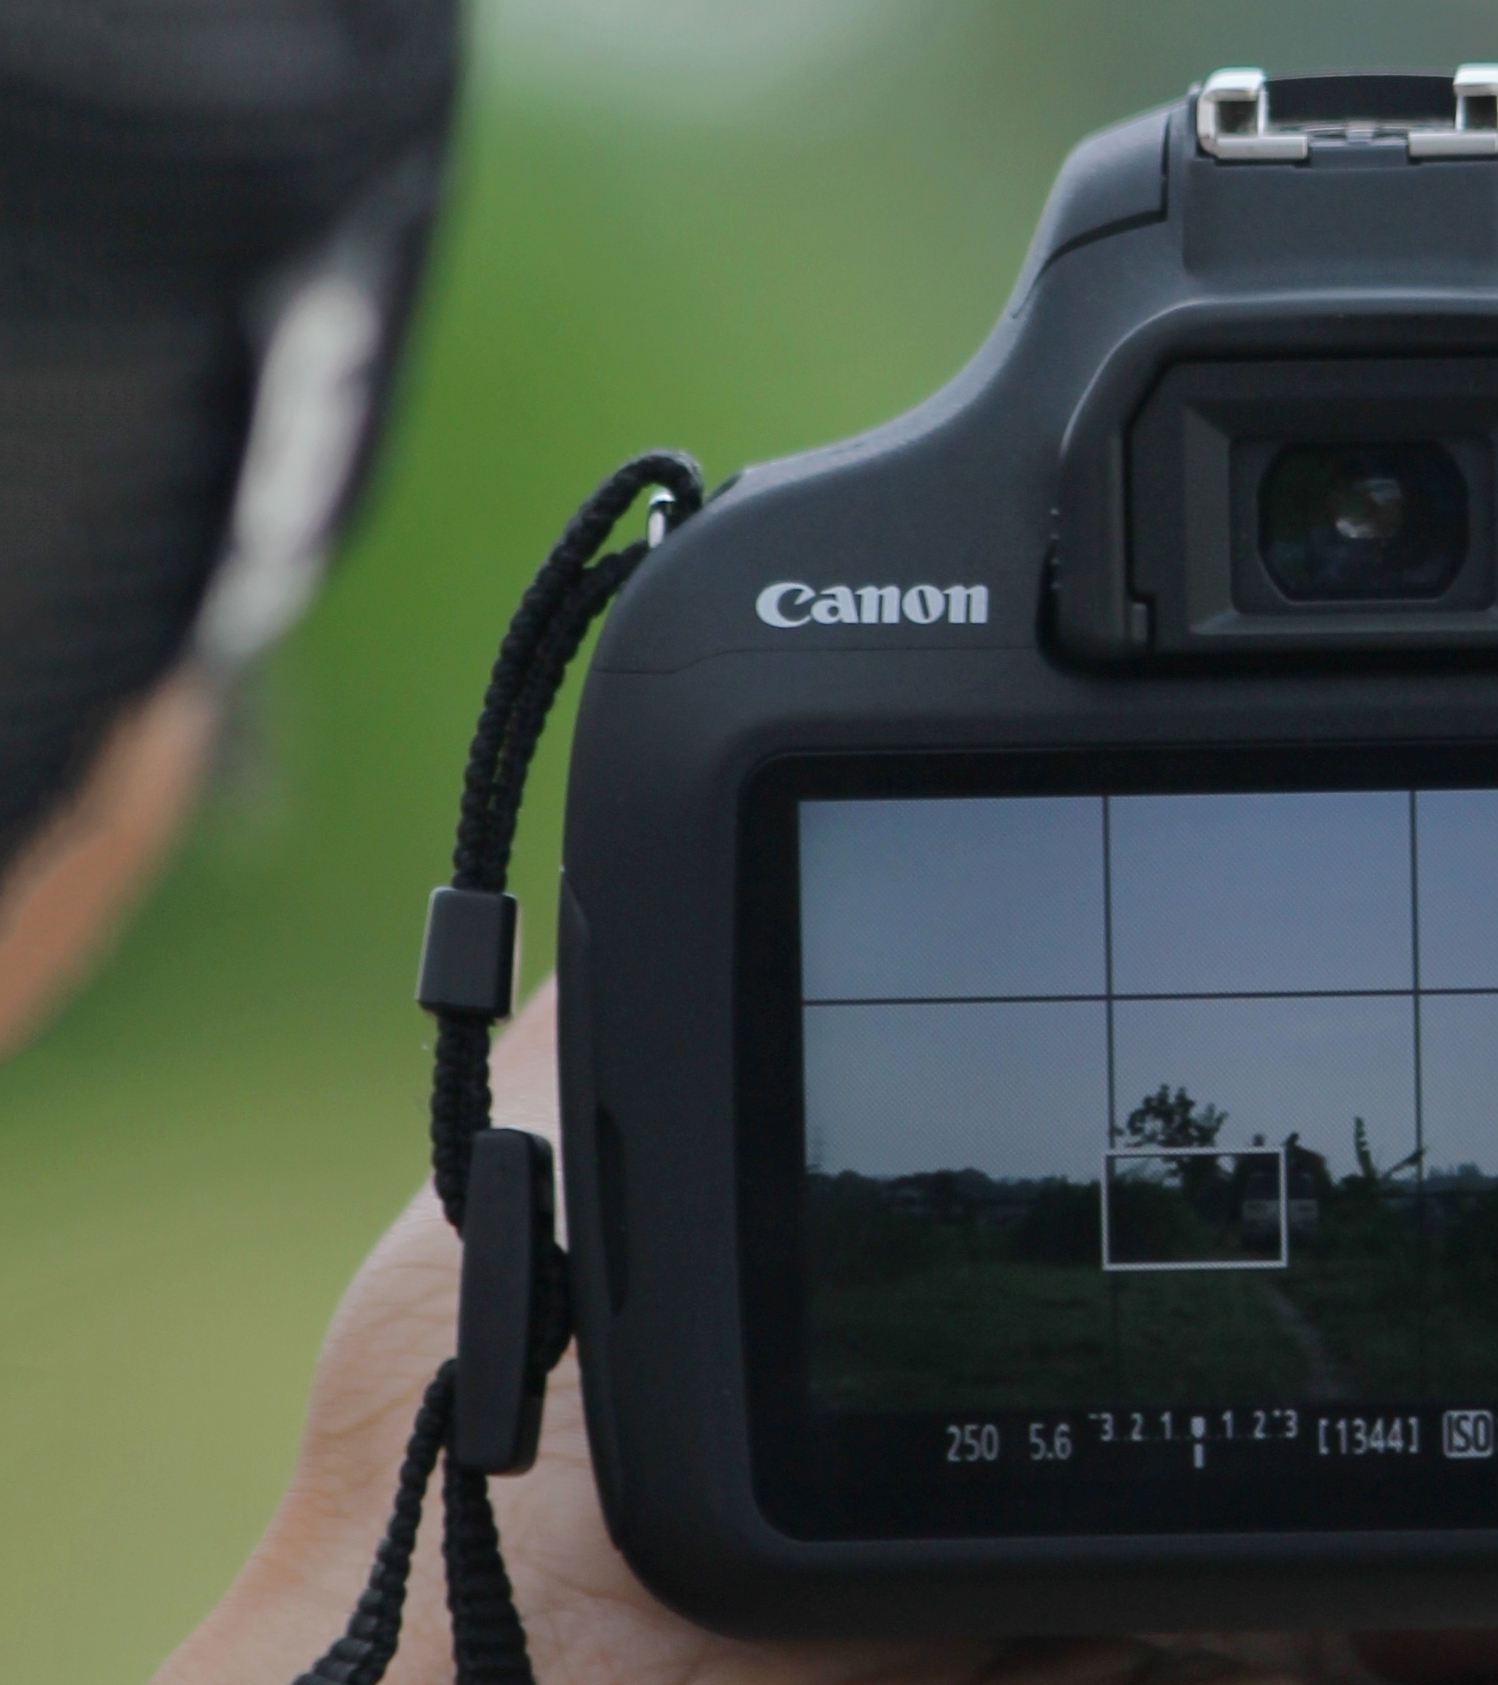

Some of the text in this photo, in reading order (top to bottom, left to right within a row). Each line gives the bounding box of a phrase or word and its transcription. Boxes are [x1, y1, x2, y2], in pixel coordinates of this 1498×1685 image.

[756, 582, 988, 628] Canon
[946, 1424, 999, 1462] 250
[1029, 1422, 1072, 1461] 5.6
[1130, 1412, 1144, 1442] 2
[1160, 1411, 1172, 1441] 1
[1221, 1410, 1233, 1440] 1
[1253, 1409, 1267, 1440] 2
[1318, 1416, 1419, 1455] [1344]
[1445, 1411, 1492, 1457] ISO
